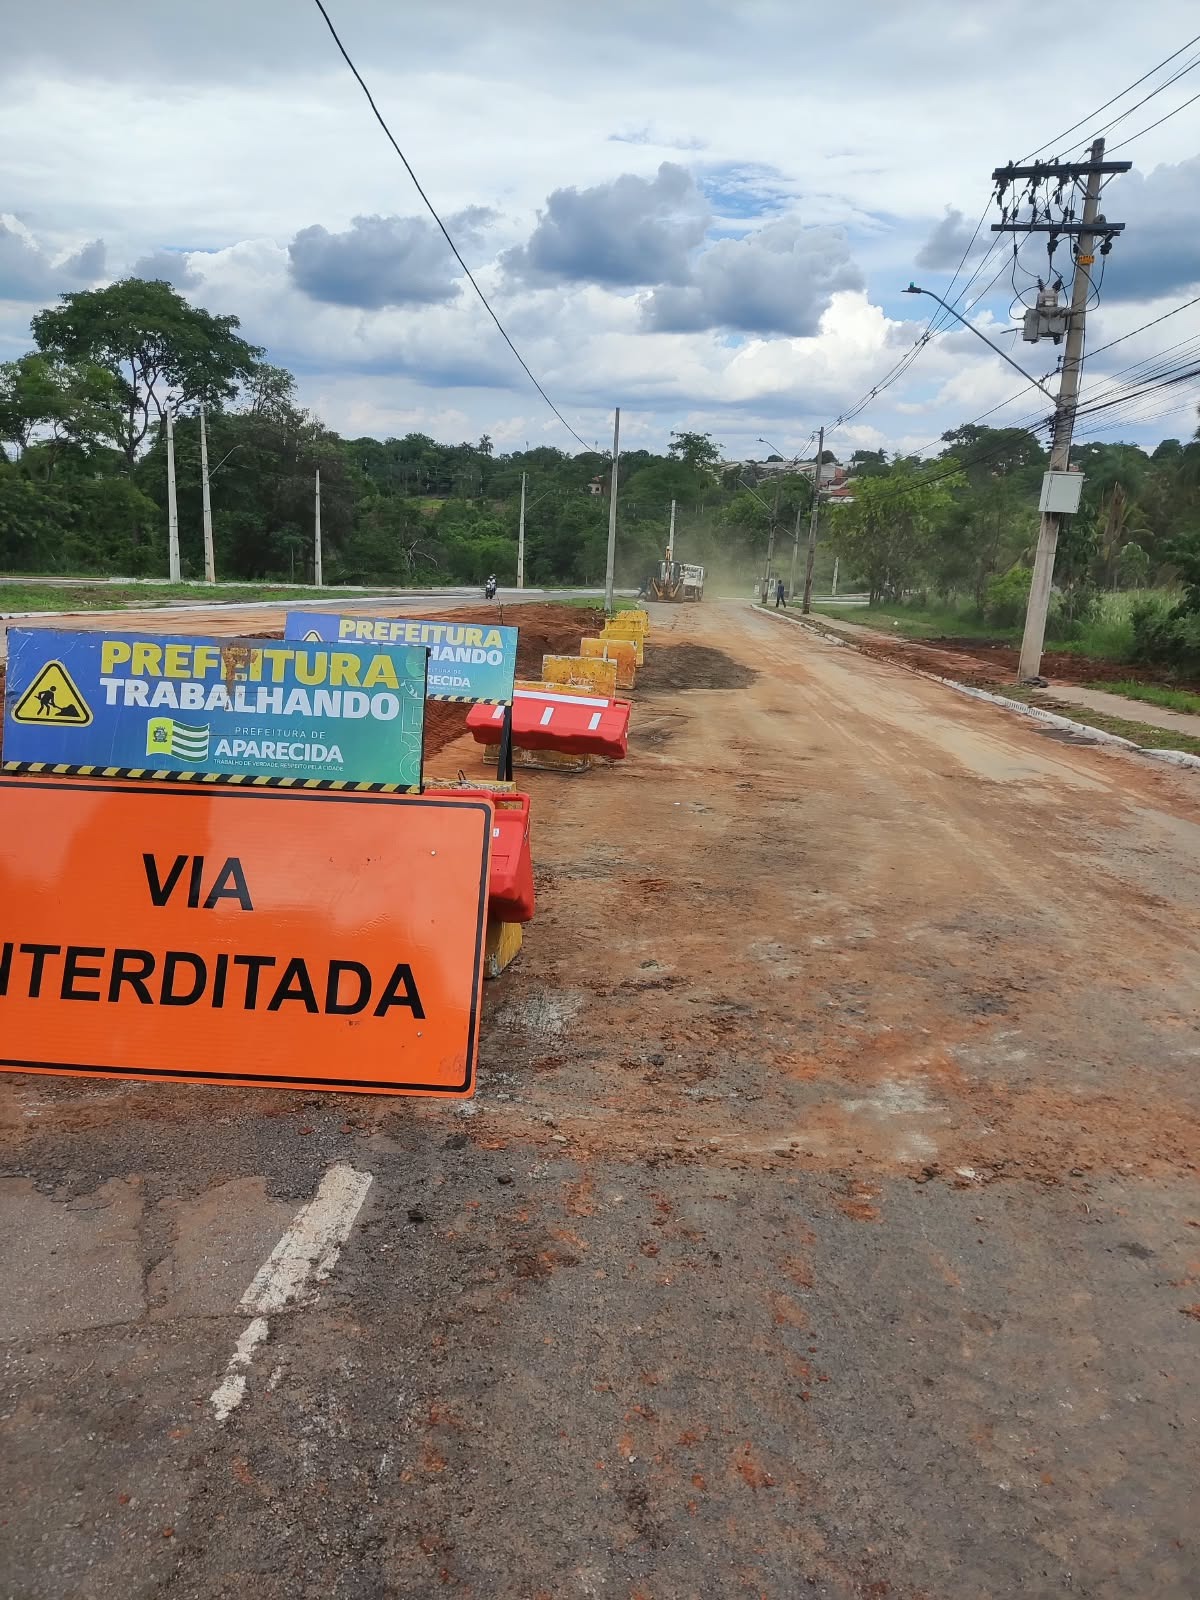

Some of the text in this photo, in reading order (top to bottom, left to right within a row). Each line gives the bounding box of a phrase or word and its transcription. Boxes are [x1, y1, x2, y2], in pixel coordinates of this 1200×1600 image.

[338, 619, 504, 649] PREFEITURA
[99, 677, 400, 721] TRABALHANDO
[214, 739, 344, 763] APARECIDA
[235, 726, 326, 740] PREFEITURA DE
[142, 853, 255, 911] VIA
[0, 942, 426, 1019] TERDITADA
